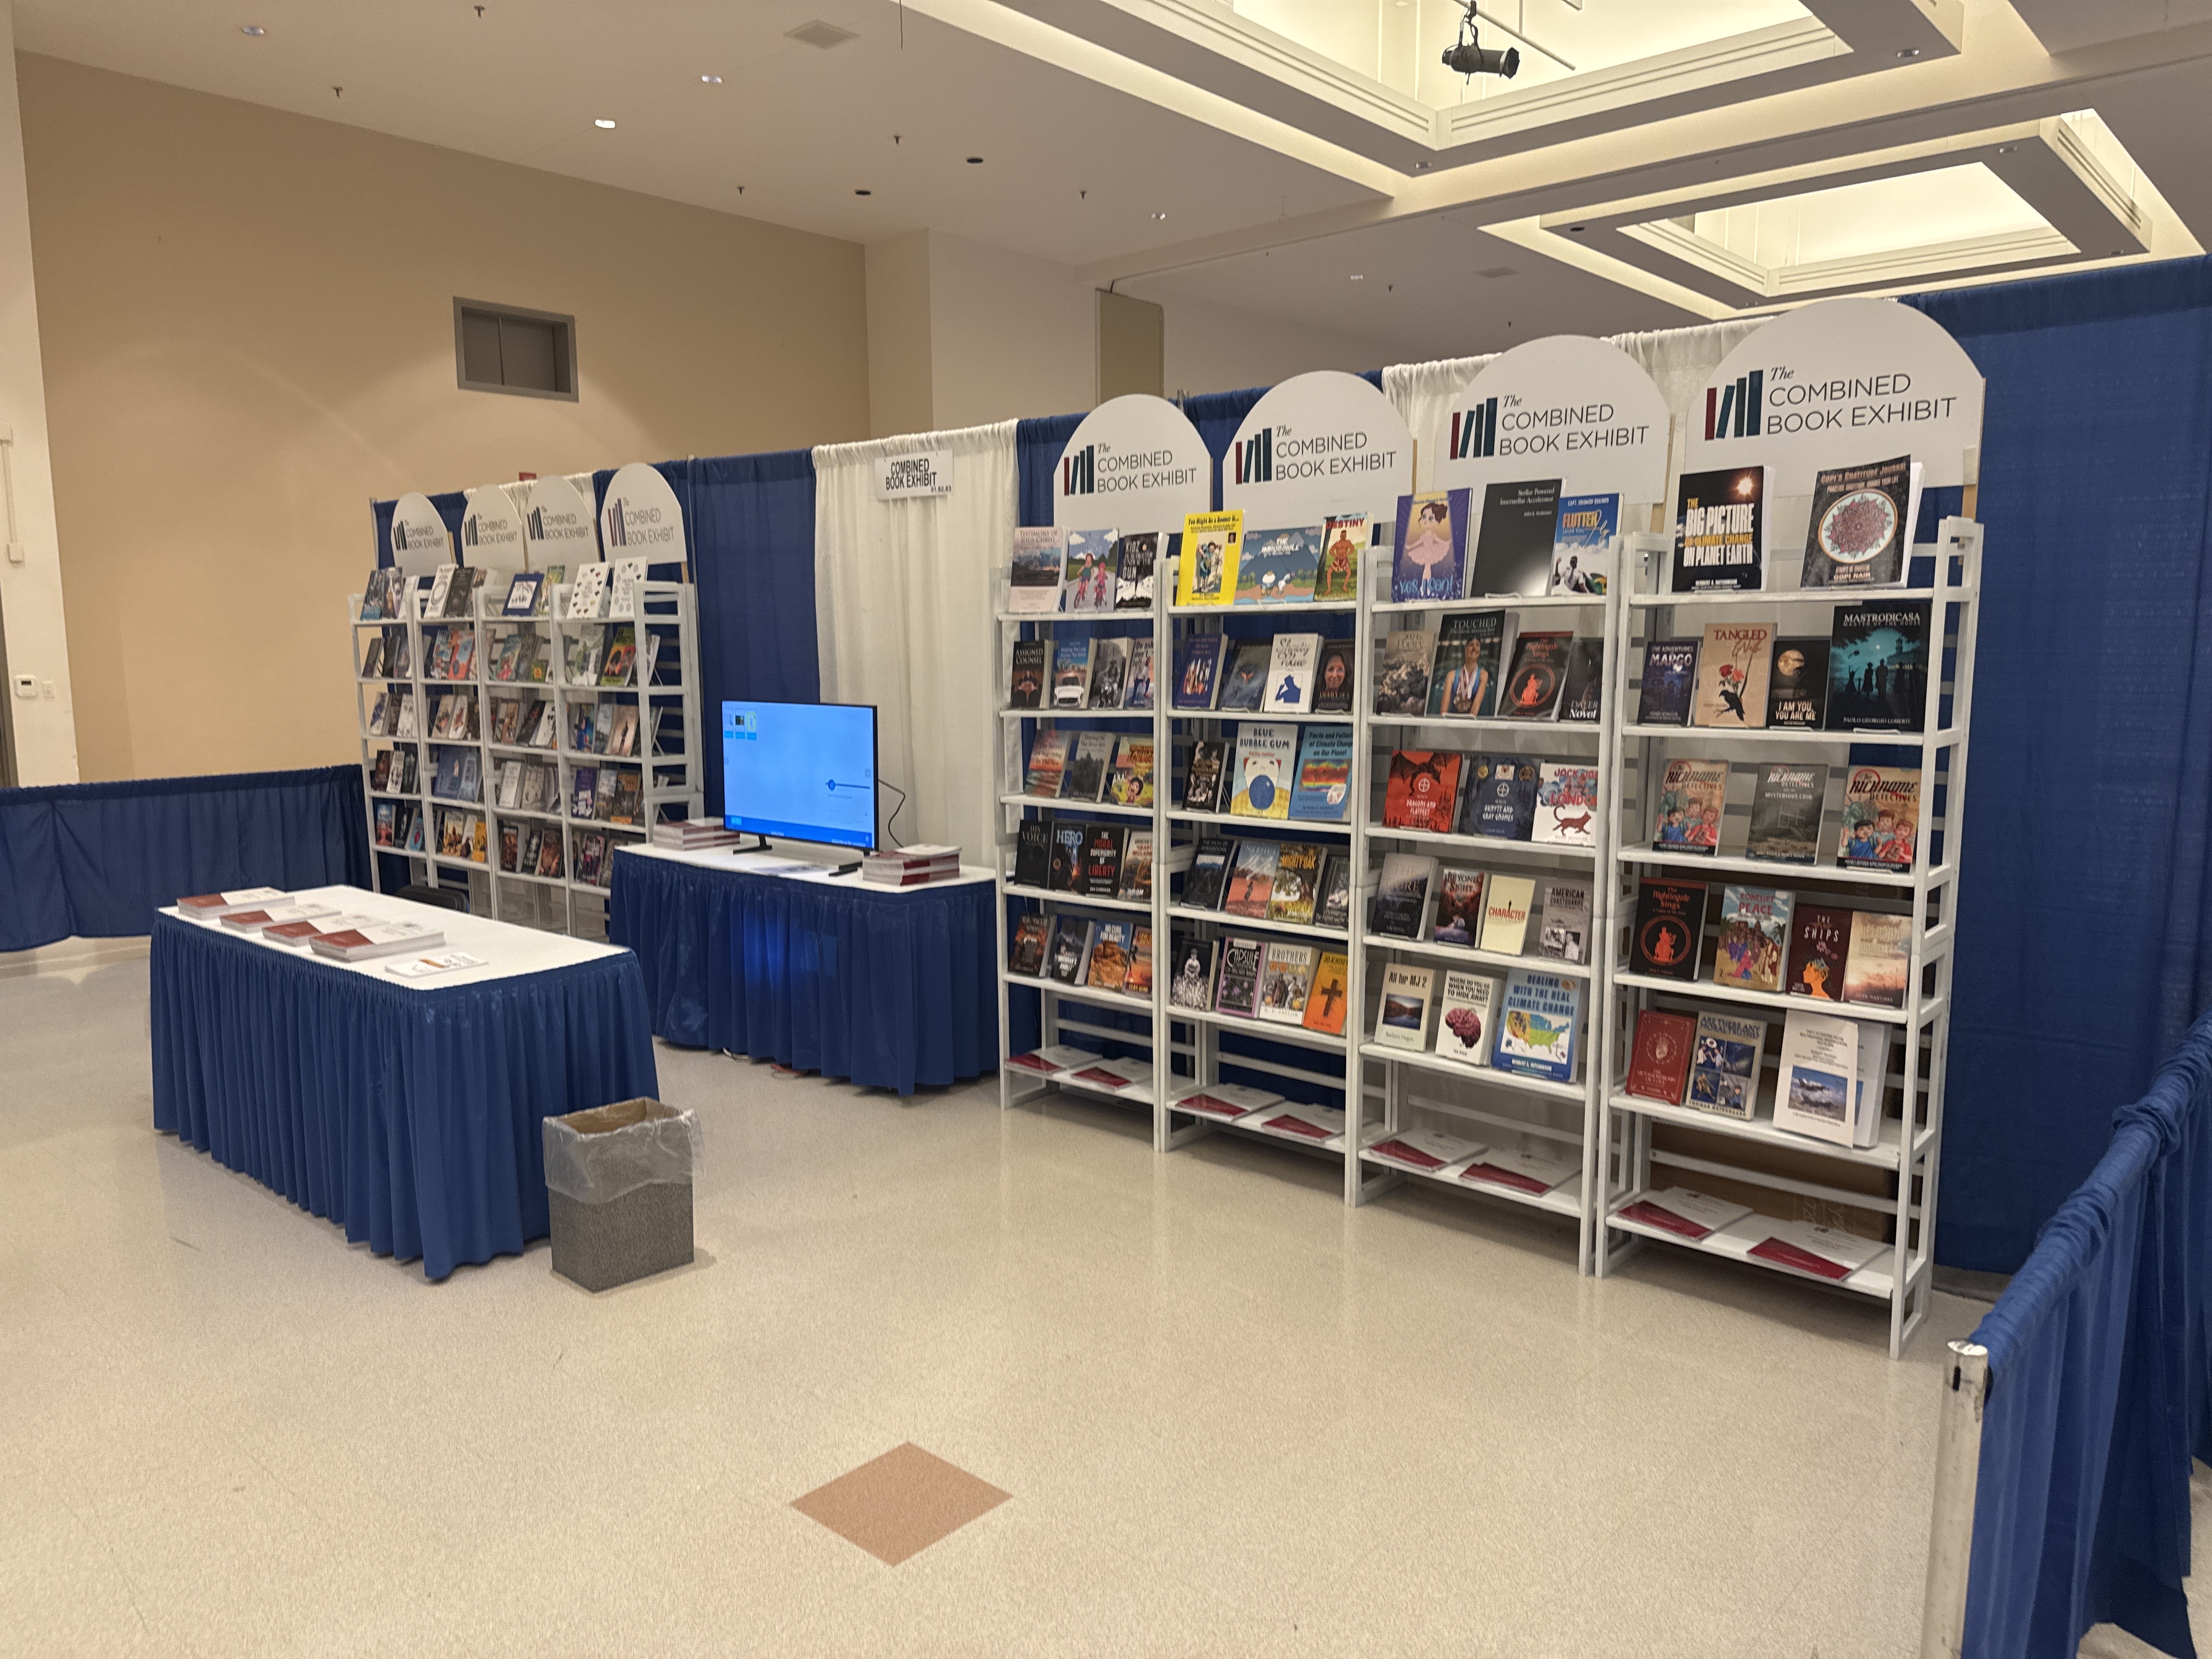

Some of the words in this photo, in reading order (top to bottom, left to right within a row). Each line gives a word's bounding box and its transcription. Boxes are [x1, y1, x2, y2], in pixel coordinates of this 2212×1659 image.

[1770, 365, 1794, 381] The
[1769, 373, 1911, 407] COMBINED
[1503, 394, 1522, 408] The
[1502, 404, 1613, 431] COMBINED
[1768, 408, 1843, 434] BOOK
[1852, 397, 1957, 426] EXHIBIT
[1277, 425, 1291, 437] The
[1277, 431, 1367, 458] COMBINED
[1500, 433, 1560, 456] BOOK
[1567, 425, 1649, 450] EXHIBIT
[1098, 443, 1110, 454] The
[891, 459, 929, 475] COMBINED
[1098, 450, 1172, 473] COMBINED
[1277, 459, 1324, 481] BOOK
[1330, 451, 1396, 474] EXHIBIT
[1844, 468, 1878, 481] GRATITUDE
[1880, 462, 1906, 475] JOURNAL
[886, 475, 905, 490] BOOK
[907, 472, 936, 488] EXHIBIT
[1098, 475, 1138, 493] BOOK
[1143, 467, 1197, 488] EXHIBIT
[1687, 498, 1699, 508] THE
[543, 514, 577, 526] COMBINED
[625, 508, 661, 526] COMBINED
[1325, 517, 1364, 530] DESTINY
[1562, 511, 1598, 528] FLUTTER
[1685, 506, 1705, 537] BIG
[1706, 503, 1754, 534] PICTURE
[406, 526, 433, 538] COMBINED
[478, 520, 507, 533] COMBINED
[479, 534, 496, 546] BOOK
[496, 532, 517, 544] EXHIBIT
[545, 528, 564, 540] BOOK
[565, 527, 589, 538] EXHIBIT
[628, 531, 648, 546] BOOK
[648, 527, 674, 544] EXHIBIT
[1685, 537, 1694, 547] OF
[1695, 535, 1723, 546] CLIMATE
[1725, 533, 1753, 545] CHANGE
[408, 539, 423, 550] BOOK
[425, 538, 444, 548] EXHIBIT
[1683, 547, 1695, 567] ON
[1696, 545, 1725, 566] PLANET
[1726, 544, 1753, 565] EARTH
[1122, 566, 1137, 579] GUN
[1428, 575, 1453, 592] Can!
[1453, 617, 1497, 629] TOUCHED
[1844, 612, 1920, 622] MASTRODICASA
[1713, 629, 1767, 640] TANGLED
[1015, 648, 1043, 657] ASSIGNED
[1016, 657, 1042, 665] COUNSEL
[1133, 658, 1142, 667] tell
[1649, 653, 1692, 667] MARGO
[1784, 701, 1795, 712] AM
[1797, 701, 1814, 713] YOU,
[1776, 710, 1788, 720] YOU
[1790, 712, 1803, 720] ARE
[1805, 712, 1816, 721] ME
[1253, 727, 1274, 737] BLUE
[1239, 738, 1267, 748] BUBBLE
[1269, 740, 1290, 749] GUM
[1554, 768, 1578, 778] JACK
[1681, 782, 1722, 790] DETECTIVES
[1870, 793, 1917, 803] DETECTIVES
[1503, 805, 1513, 813] AND
[1495, 813, 1514, 822] GNOMES
[1030, 825, 1040, 833] HIS
[1022, 831, 1048, 843] VOICE
[1057, 829, 1083, 845] HERO
[1094, 839, 1113, 849] MORAL
[1282, 855, 1303, 867] MIGHTY
[1304, 856, 1316, 870] OAK
[1088, 865, 1115, 877] LIBERTY
[1396, 864, 1419, 876] THE
[1551, 887, 1584, 899] AMERICAN
[1652, 890, 1691, 903] Nightingale
[1740, 893, 1775, 904] CONFLICT
[1660, 899, 1680, 910] Sings
[1739, 901, 1773, 915] PEACE
[1488, 906, 1526, 921] CHARACTER
[1817, 915, 1830, 924] THE
[1111, 924, 1122, 933] CURE
[1804, 926, 1839, 943] SHIPS
[1100, 932, 1108, 941] FOR
[1109, 933, 1125, 944] BEAUTY
[1227, 947, 1259, 972] CAPSULE
[1272, 948, 1307, 964] BROTHERS
[1397, 972, 1408, 984] for
[1409, 974, 1421, 987] MJ
[1422, 977, 1427, 987] 2
[1449, 976, 1466, 985] WHERE
[1474, 980, 1483, 988] YOU
[1527, 974, 1559, 988] DEALING
[1448, 983, 1465, 992] WHEN
[1465, 985, 1477, 994] YOU
[1477, 988, 1489, 996] NEED
[1514, 985, 1532, 997] WITH
[1535, 988, 1549, 999] THE
[1551, 990, 1570, 1003] REAL
[1456, 991, 1470, 1000] HIDE
[1470, 993, 1488, 1003] AWAY?
[1508, 996, 1541, 1011] CLIMATE
[1543, 1001, 1576, 1017] CHANGE
[1700, 1022, 1726, 1035] MORAL
[1701, 1016, 1717, 1026] ARE
[1718, 1018, 1742, 1031] THERE
[1743, 1023, 1761, 1035] ANY
